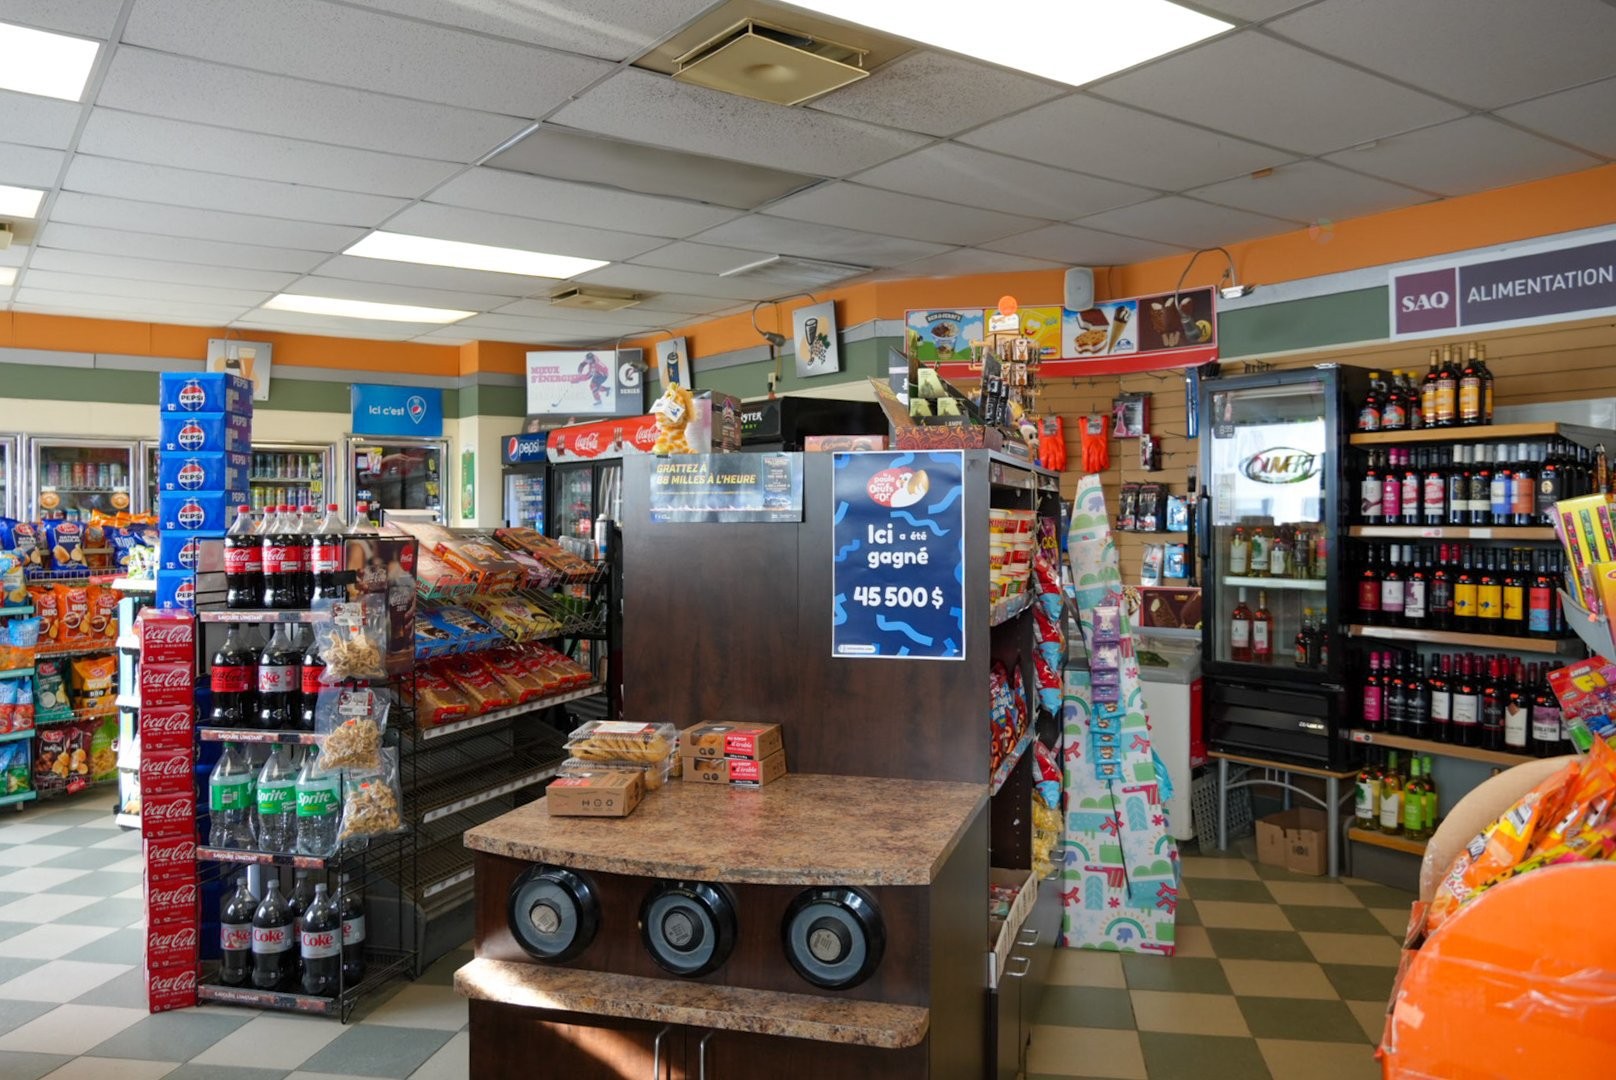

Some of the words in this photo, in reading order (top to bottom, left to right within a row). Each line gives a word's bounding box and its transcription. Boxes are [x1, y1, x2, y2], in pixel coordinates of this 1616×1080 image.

[1402, 291, 1449, 313] SAQ
[1467, 265, 1613, 303] ALIMENTATION
[369, 405, 381, 415] Ici
[382, 406, 405, 416] c'est
[742, 412, 762, 422] STER
[518, 439, 540, 456] pepsi
[575, 433, 599, 450] Coca-Cola
[656, 464, 699, 473] GRATTEZ
[671, 474, 706, 484] MILLES
[706, 472, 715, 484] À
[716, 474, 756, 484] L'HEURE
[868, 523, 893, 544] Ici
[899, 533, 906, 541] a
[910, 531, 927, 541] été
[868, 547, 929, 568] gagné
[853, 586, 881, 606] 45
[885, 587, 928, 607] 500
[932, 586, 944, 609] $
[257, 790, 287, 802] Sprite
[298, 791, 331, 806] Sprite
[221, 928, 250, 943] Coke
[254, 928, 284, 943] Coke
[303, 934, 333, 947] Coke
